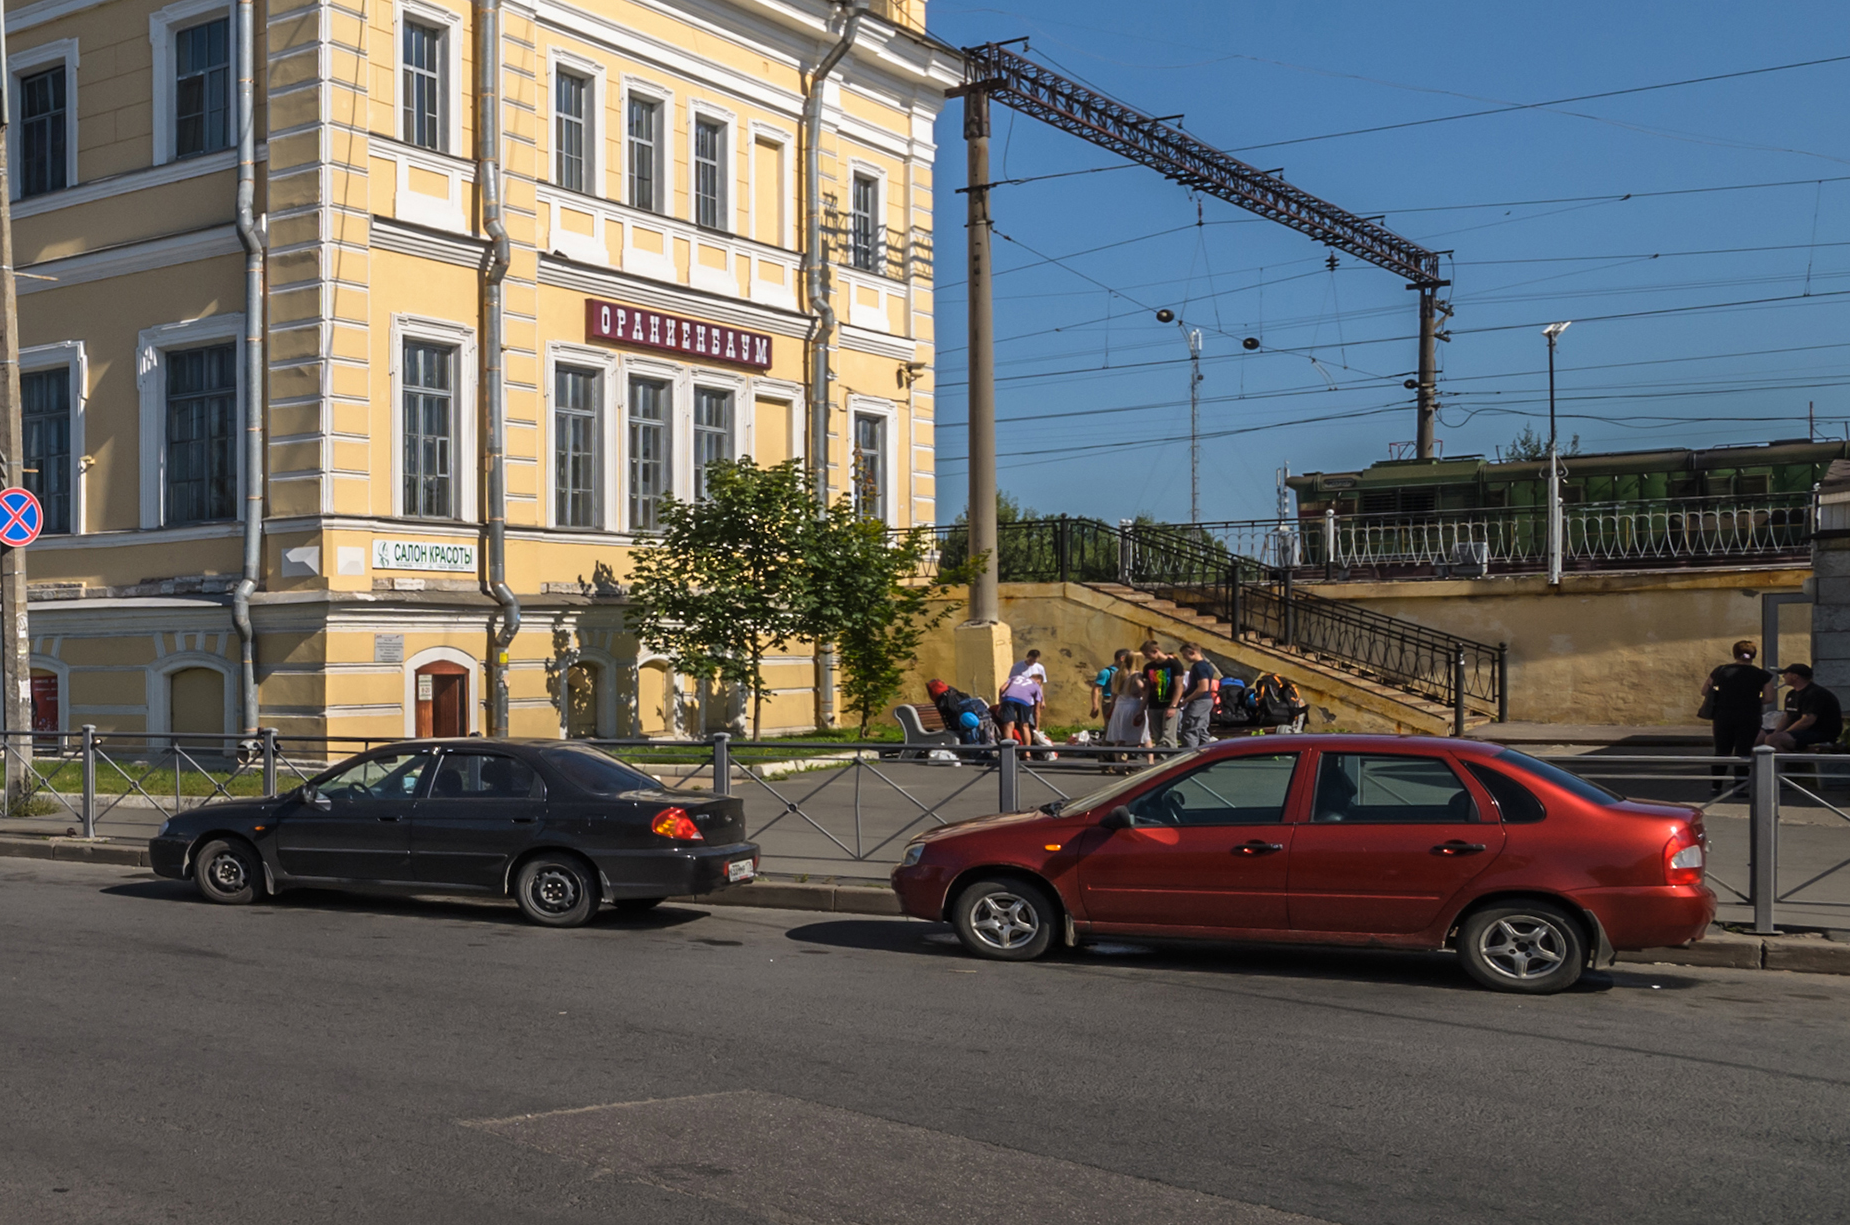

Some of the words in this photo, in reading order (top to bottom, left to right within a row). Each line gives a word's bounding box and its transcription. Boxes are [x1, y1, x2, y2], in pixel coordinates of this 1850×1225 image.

[601, 305, 767, 364] ОРАНИЕНБАУМ
[394, 543, 427, 562] САЛОН
[429, 545, 472, 564] КРАСОТЫ
[1013, 675, 1033, 686] 57
